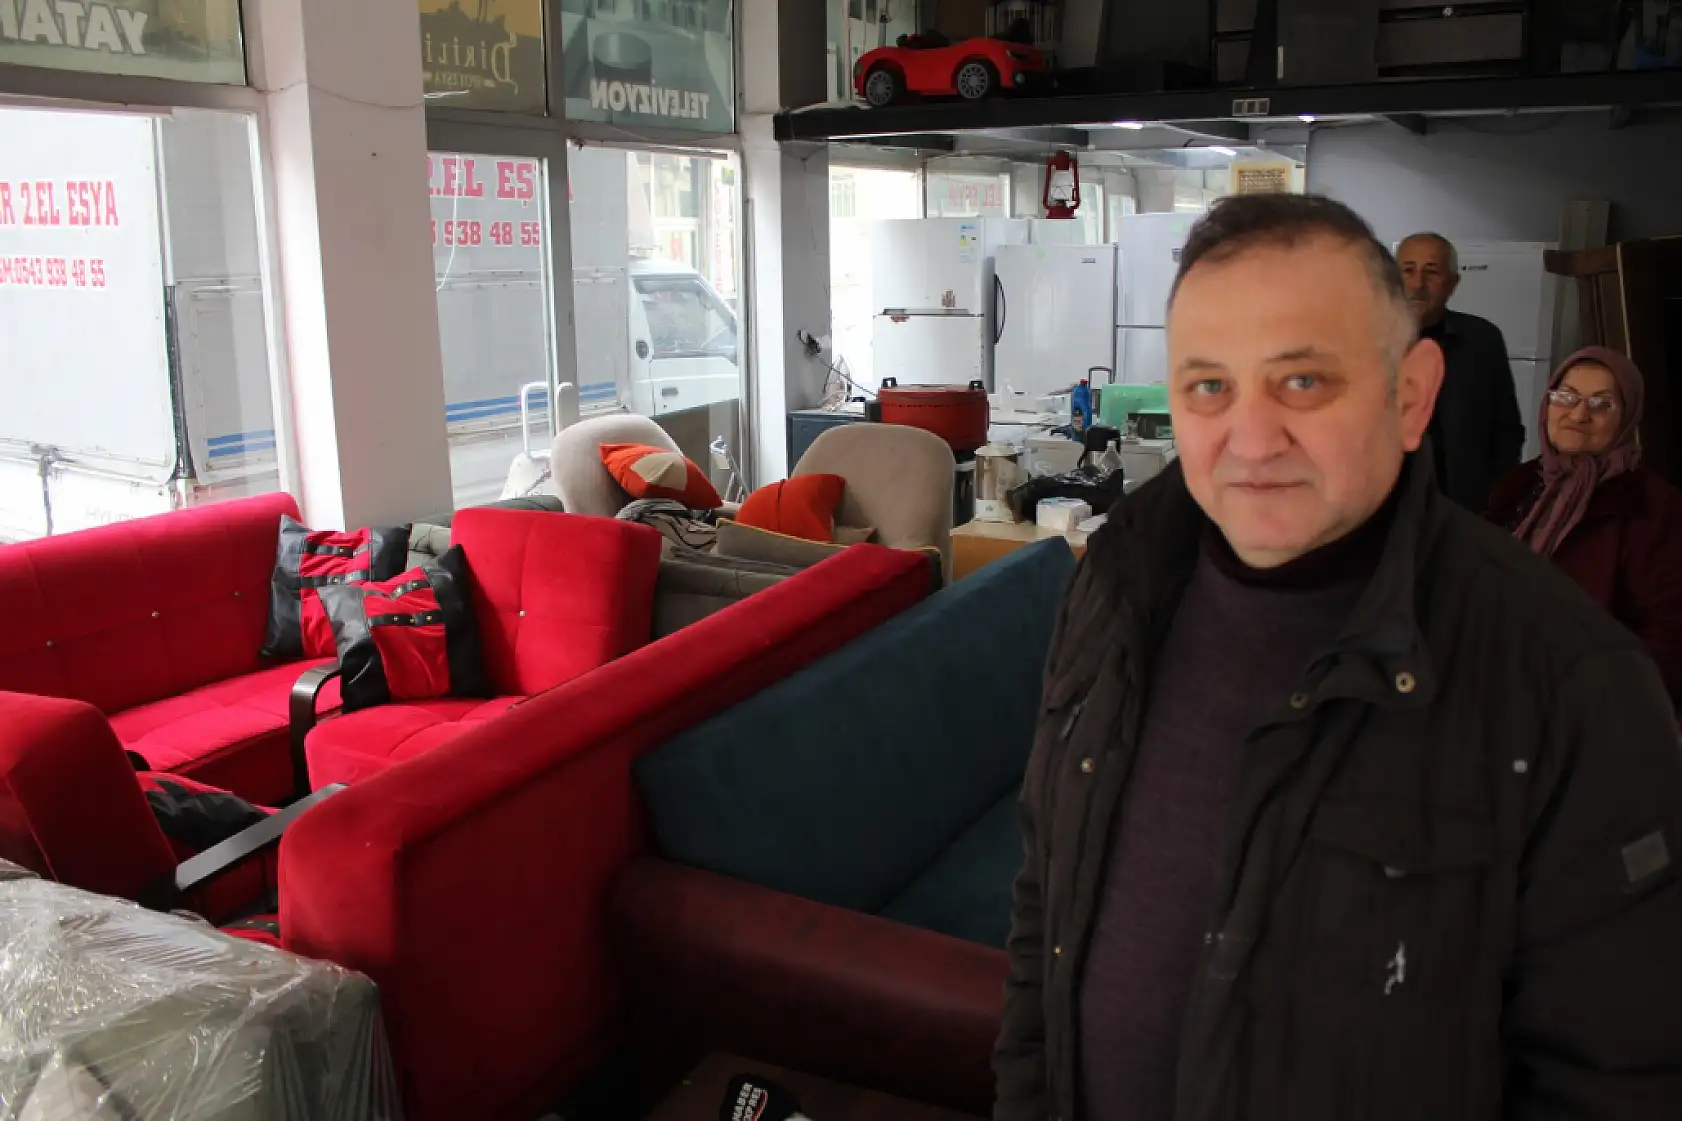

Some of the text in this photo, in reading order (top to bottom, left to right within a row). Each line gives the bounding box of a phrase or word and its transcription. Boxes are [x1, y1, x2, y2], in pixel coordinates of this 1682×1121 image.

[0, 181, 16, 225] R
[20, 181, 60, 226] 2.EL
[443, 220, 482, 246] 938
[489, 221, 513, 246] 48
[520, 221, 541, 246] 55
[72, 257, 87, 288] 48
[90, 258, 106, 289] 55
